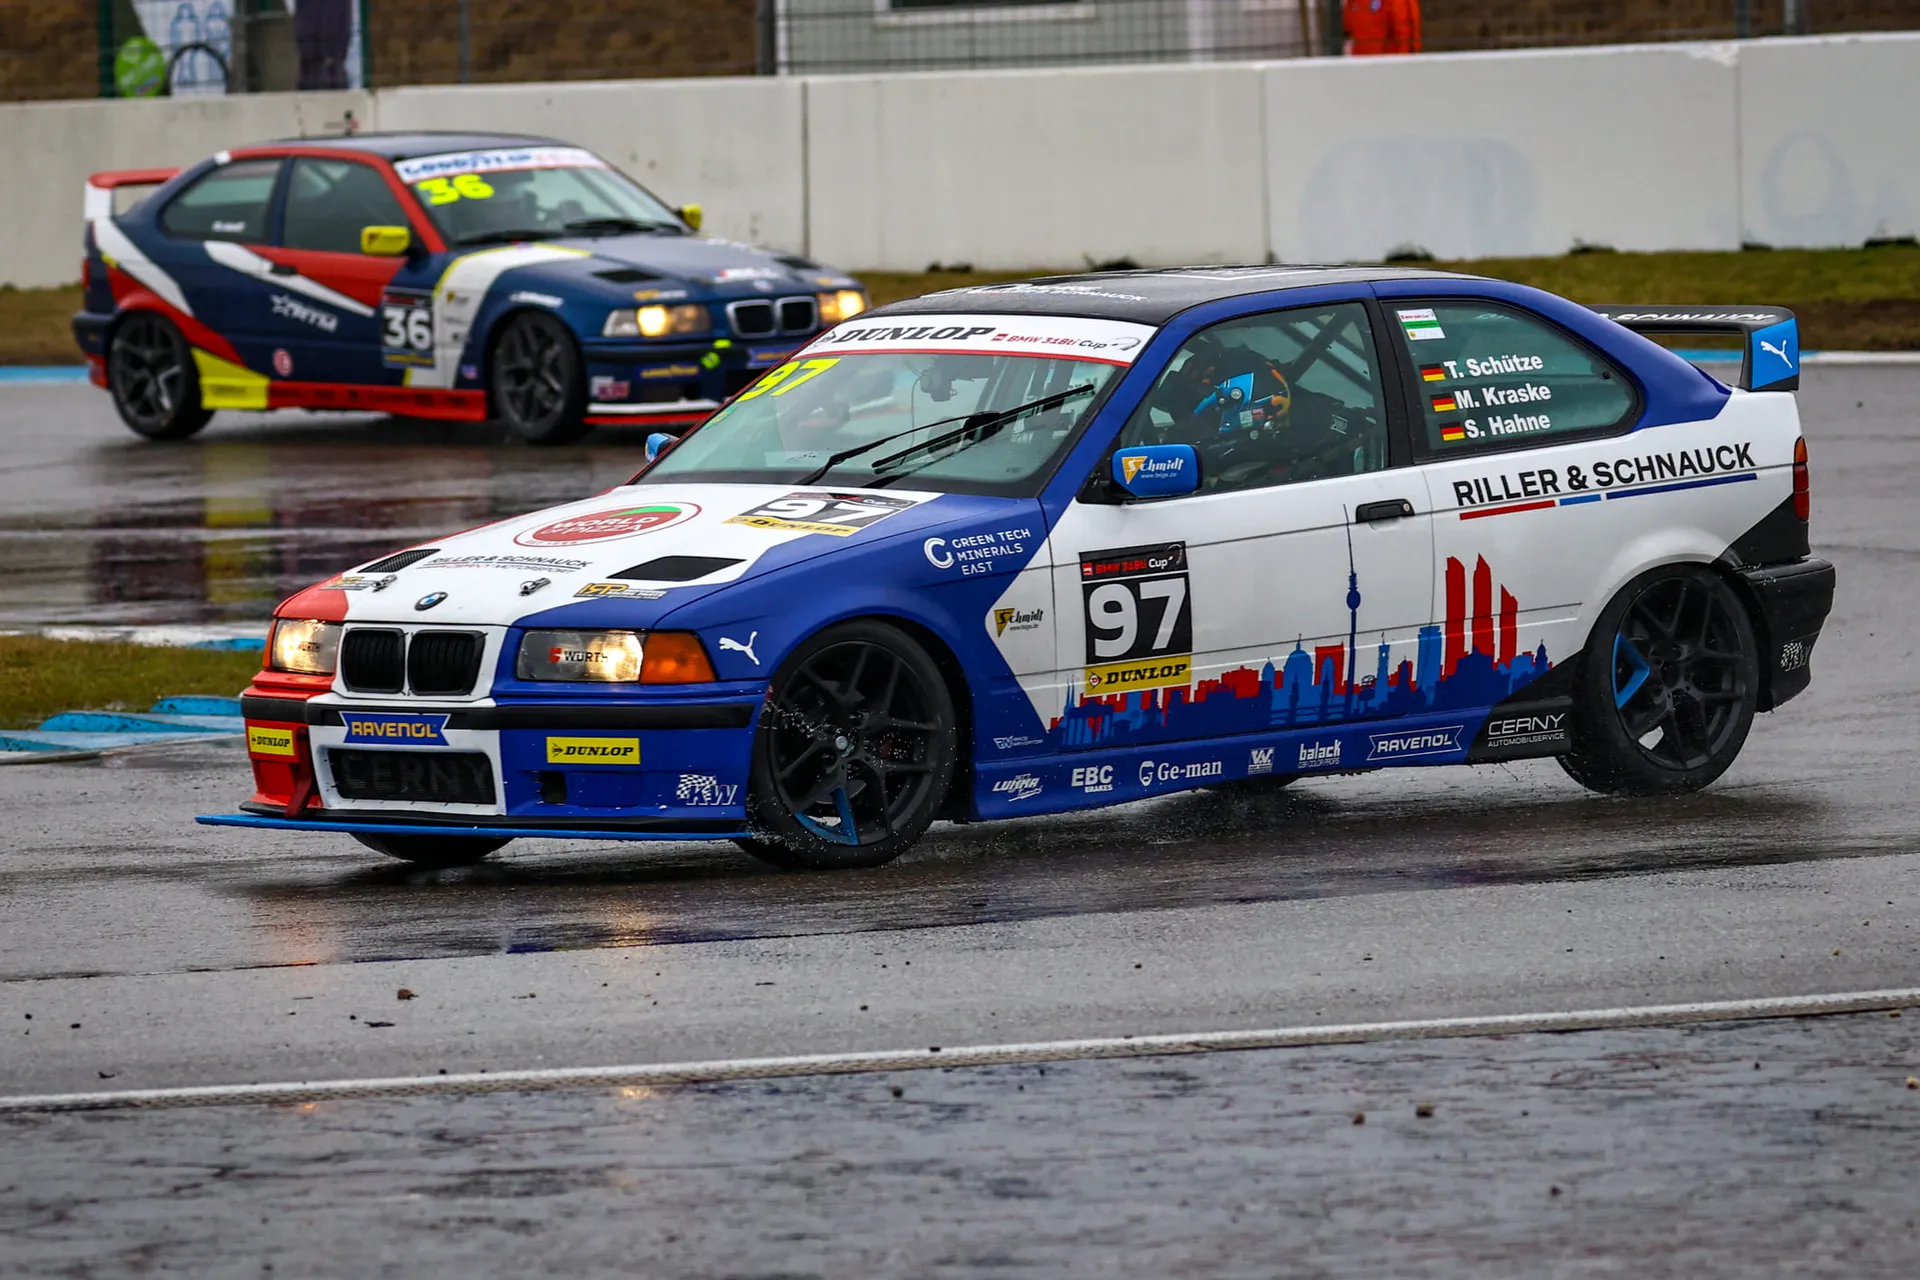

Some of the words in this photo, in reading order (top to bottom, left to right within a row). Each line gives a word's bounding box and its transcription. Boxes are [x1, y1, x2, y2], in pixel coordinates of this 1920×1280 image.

[417, 173, 495, 205] 36
[383, 307, 433, 350] 36
[835, 326, 997, 344] DUNLOP
[1006, 335, 1042, 344] BMW
[1079, 340, 1108, 350] Cup
[1443, 360, 1465, 379] T.
[1468, 353, 1544, 377] Schütze
[736, 358, 841, 402] 97
[1454, 390, 1480, 410] M.
[1482, 382, 1552, 406] Kraske
[1464, 419, 1486, 439] S.
[1488, 413, 1551, 435] Hahne
[1126, 457, 1184, 473] Schmidt
[1452, 468, 1561, 507] RILLER
[1567, 464, 1588, 491] &
[1592, 442, 1757, 487] SCHNAUCK
[753, 499, 894, 523] 97
[552, 516, 660, 529] WORLD
[751, 518, 851, 533] DUNLOP
[952, 534, 996, 549] GREEN
[997, 528, 1031, 543] TECH
[501, 555, 594, 568] SCHNAUCK
[957, 543, 1024, 562] MINERALS
[961, 561, 993, 576] EAST
[1148, 558, 1168, 569] Cup
[998, 608, 1044, 624] Schmidt
[1089, 577, 1186, 658] 97
[1105, 663, 1187, 685] DUNLOP
[351, 721, 438, 738] RAVENOL
[1488, 713, 1566, 736] CERNY
[256, 735, 291, 748] DUNLOP
[1298, 739, 1342, 761] balack
[1376, 733, 1454, 754] RAVENOL
[1487, 732, 1566, 748] AUTOMOBILSERVICE
[564, 746, 634, 757] DUNLOP
[1071, 765, 1114, 787] EBC
[1157, 760, 1223, 782] Ge-man
